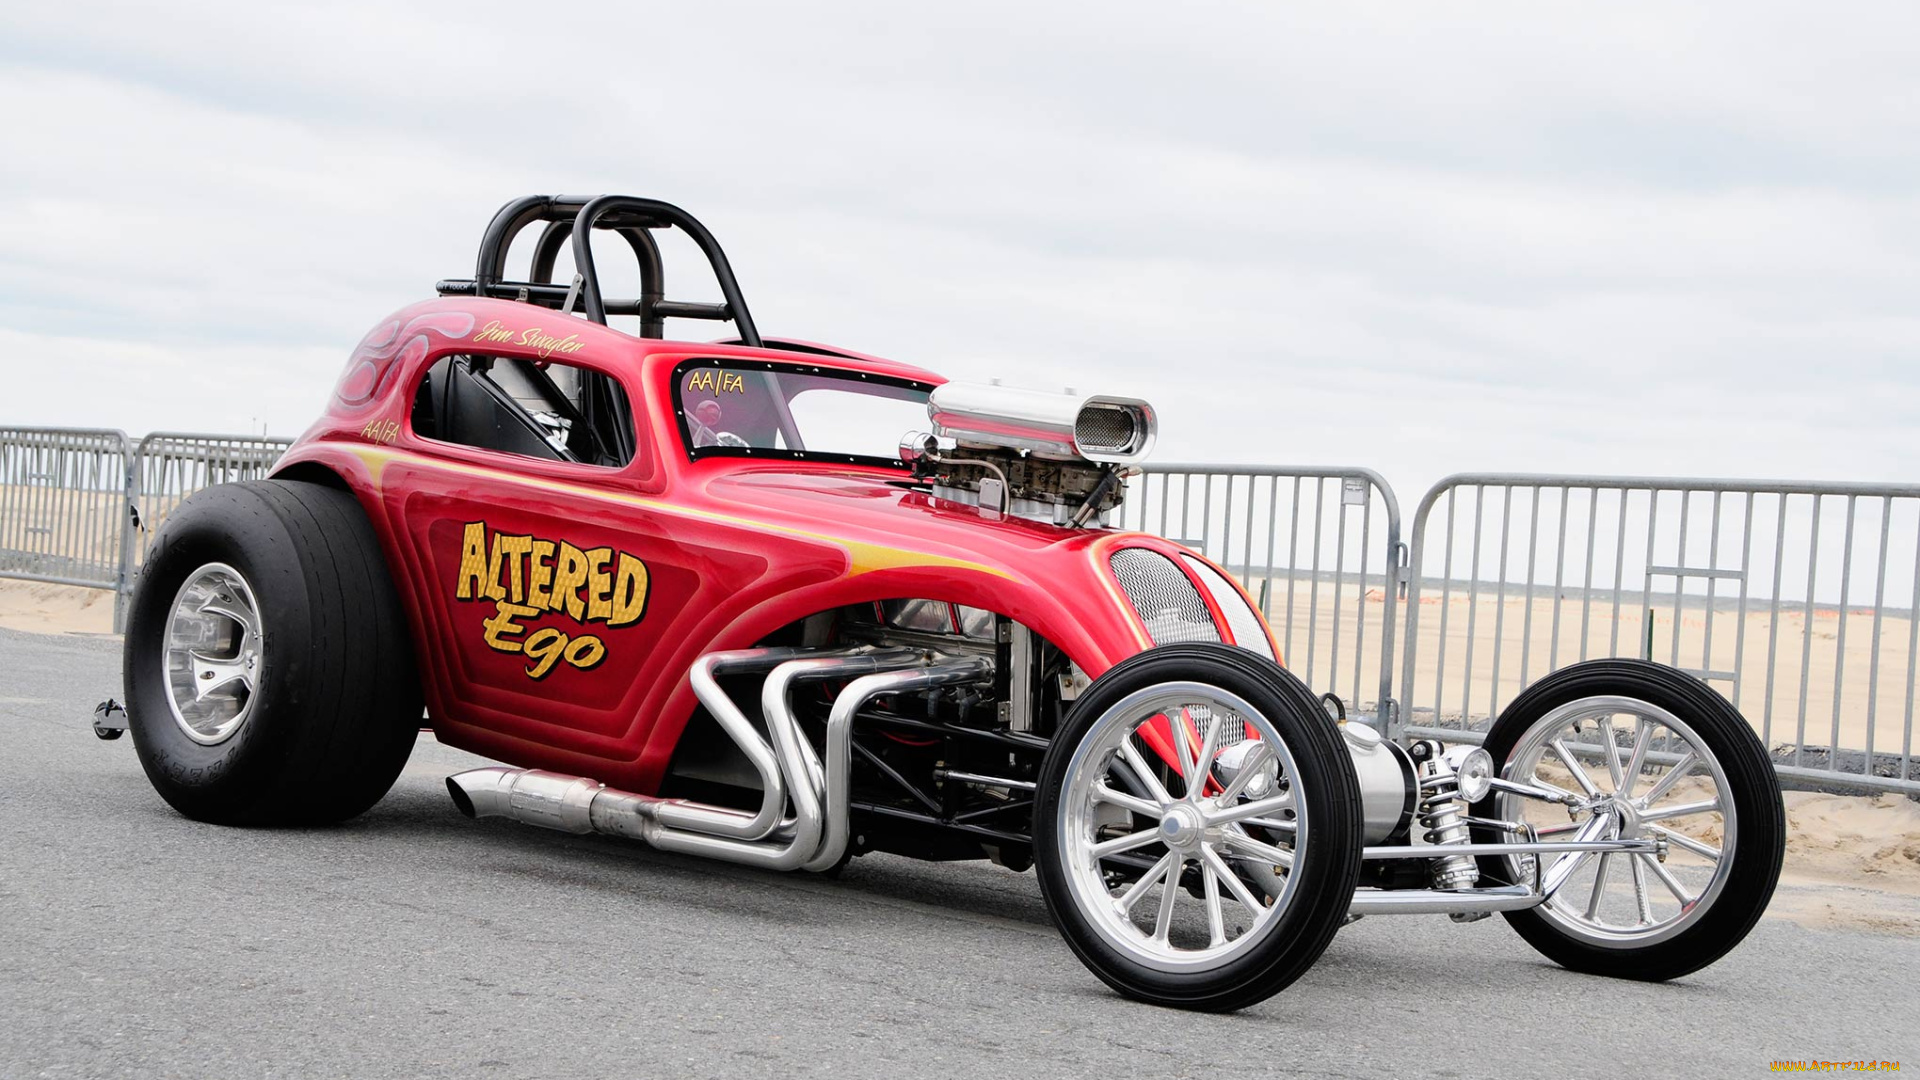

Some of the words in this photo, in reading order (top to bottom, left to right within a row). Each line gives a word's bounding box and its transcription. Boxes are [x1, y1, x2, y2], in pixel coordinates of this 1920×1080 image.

[473, 319, 514, 342] Jim
[513, 327, 585, 359] Swagler
[688, 368, 744, 397] AA/FA
[360, 417, 400, 447] AA/FA
[457, 521, 650, 627] ALTERED
[483, 599, 606, 680] Ego
